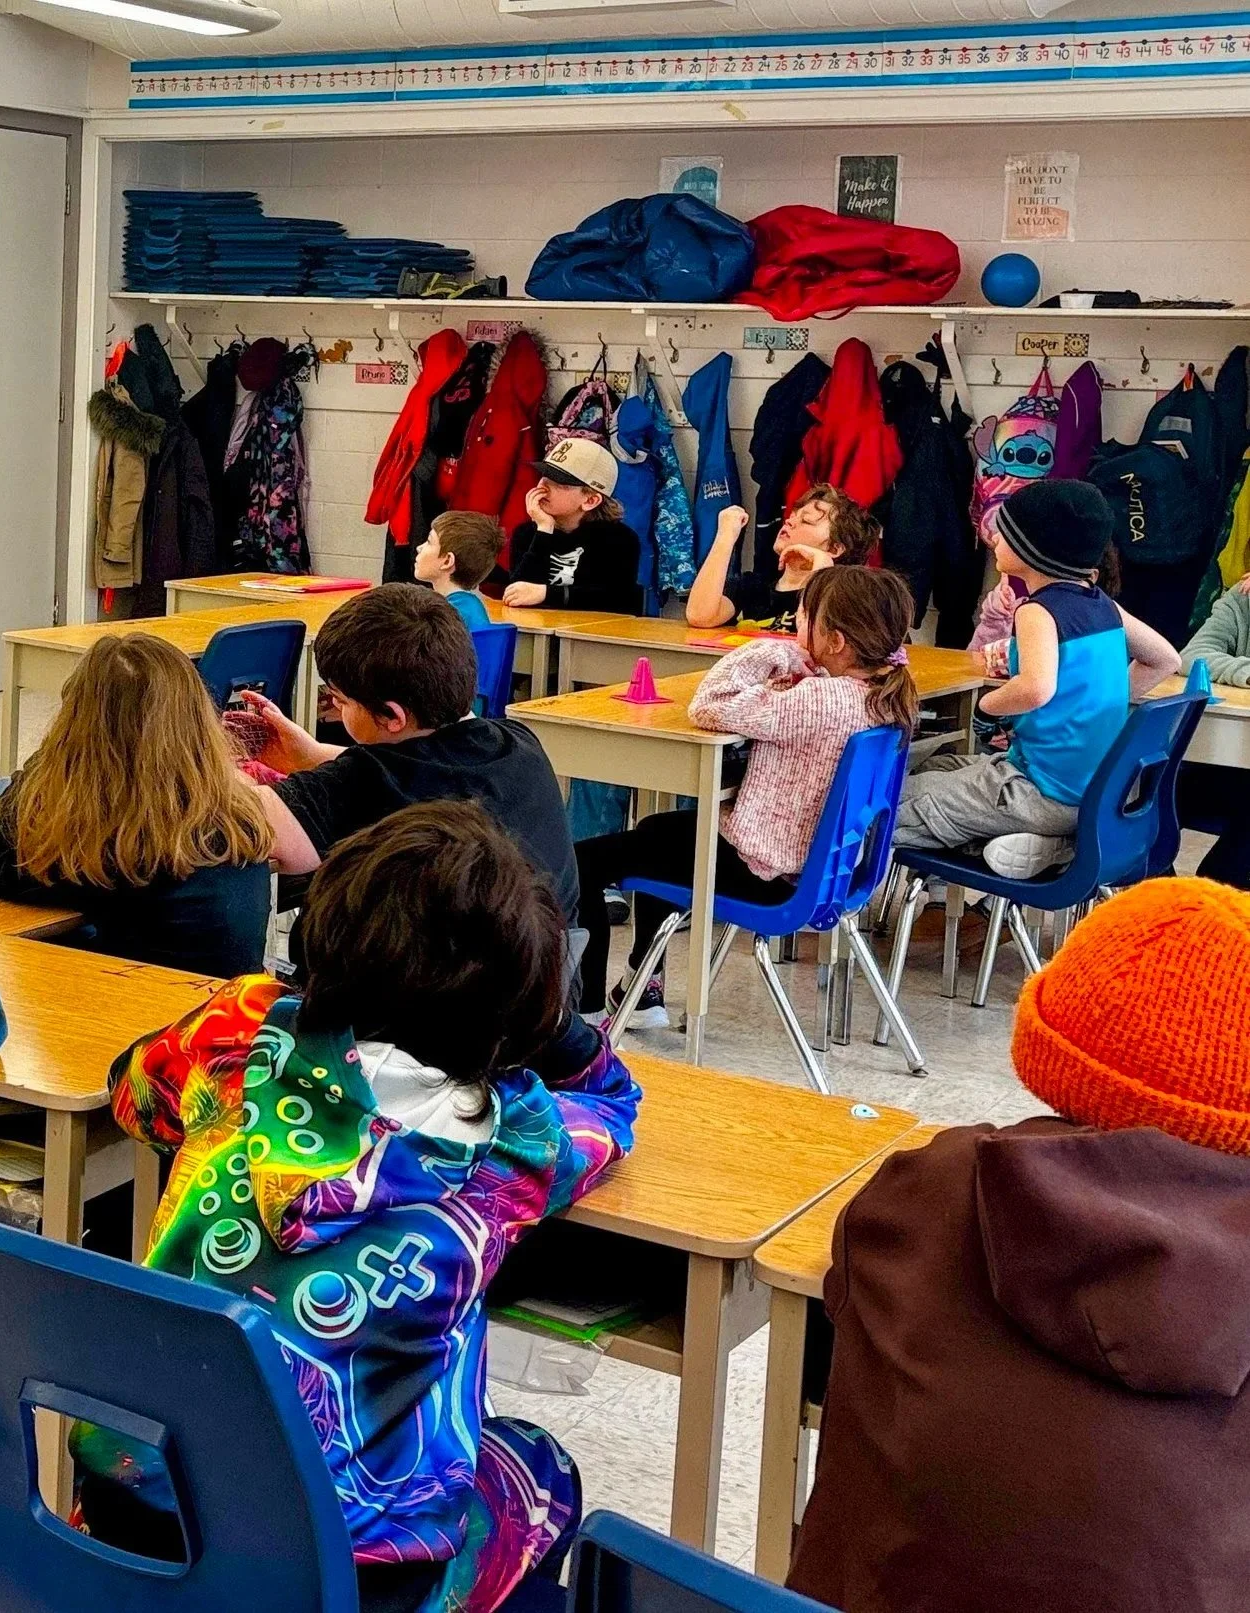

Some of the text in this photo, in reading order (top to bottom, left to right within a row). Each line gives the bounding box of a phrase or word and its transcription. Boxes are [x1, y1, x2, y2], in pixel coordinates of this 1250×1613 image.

[397, 74, 404, 85] 0
[411, 74, 415, 84] 1
[423, 74, 430, 84] 2
[437, 74, 443, 83] 3
[450, 72, 456, 82] 4
[463, 72, 470, 82] 5
[477, 72, 483, 81] 6
[491, 70, 497, 80] 7
[505, 70, 511, 80] 8
[519, 70, 525, 79] 9
[530, 68, 540, 79] 10
[549, 68, 555, 78] 11
[562, 68, 571, 77] 12
[578, 67, 587, 77] 13
[593, 67, 603, 76] 14
[609, 66, 618, 76] 15
[625, 65, 634, 75] 16
[642, 65, 651, 74] 17
[658, 64, 667, 74] 18
[674, 64, 683, 74] 19
[689, 63, 702, 74] 20
[709, 62, 718, 73] 21
[723, 62, 737, 72] 22
[741, 61, 753, 72] 23
[758, 61, 770, 71] 24
[774, 60, 788, 71] 25
[792, 60, 806, 70] 26
[810, 59, 823, 70] 27
[828, 58, 840, 69] 28
[845, 58, 859, 69] 29
[863, 58, 878, 68] 30
[885, 57, 895, 67] 31
[901, 57, 915, 66] 32
[920, 56, 934, 65] 33
[938, 55, 952, 65] 34
[957, 54, 971, 64] 35
[976, 53, 991, 63] 36
[996, 52, 1010, 62] 37
[1015, 51, 1029, 62] 38
[1035, 50, 1049, 61] 39
[1054, 50, 1070, 60] 40
[1077, 49, 1088, 59] 41
[1096, 48, 1110, 59] 42
[1116, 47, 1131, 58] 43
[1136, 46, 1152, 57] 44
[1156, 45, 1173, 56] 45
[1178, 44, 1194, 55] 46
[1200, 43, 1215, 54] 47
[1220, 42, 1236, 53] 48
[845, 176, 895, 193] Make it
[1018, 176, 1062, 185] HAVE TO
[1033, 187, 1047, 195] BE
[846, 196, 890, 213] Happen
[1018, 197, 1061, 205] PERFECT
[1025, 207, 1051, 215] TO BE
[1017, 217, 1060, 226] AMAZING
[1120, 472, 1146, 542] NAUTICA
